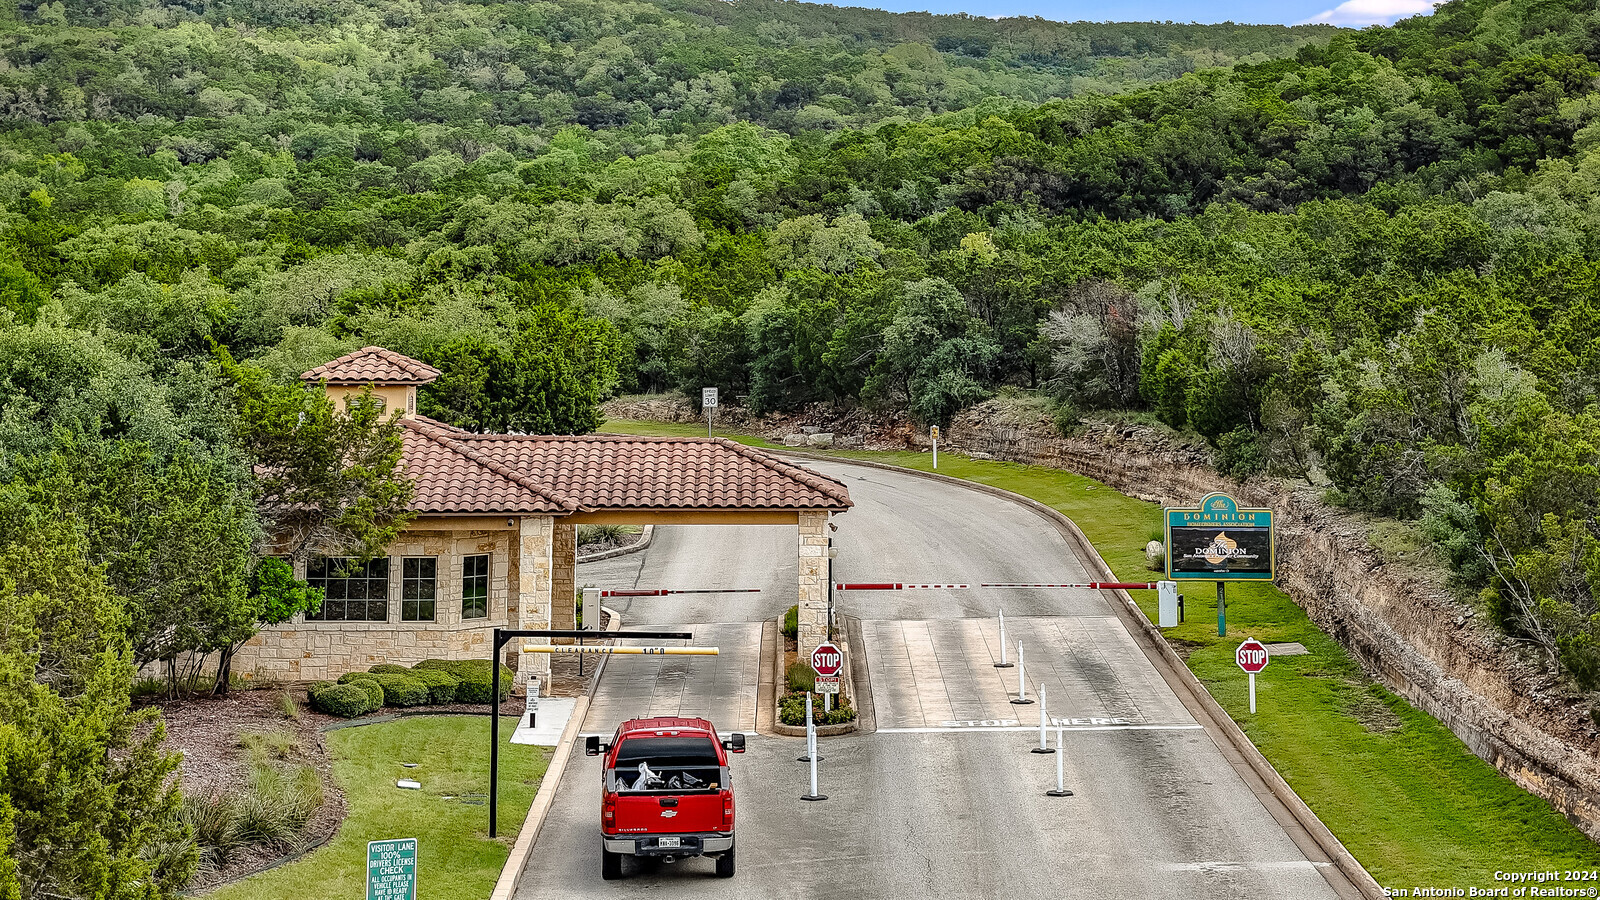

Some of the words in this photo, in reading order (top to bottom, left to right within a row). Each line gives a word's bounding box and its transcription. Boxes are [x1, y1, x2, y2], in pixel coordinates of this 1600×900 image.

[1209, 539, 1228, 548] The
[814, 653, 839, 668] STOP
[1240, 650, 1265, 664] STOP
[941, 719, 1020, 727] STOP
[371, 844, 394, 852] VISITOR
[398, 842, 414, 850] LANE
[381, 851, 401, 860] 100%
[370, 860, 391, 868] DRIVERS
[394, 858, 414, 866] LICENSE
[380, 866, 404, 875] CHECK
